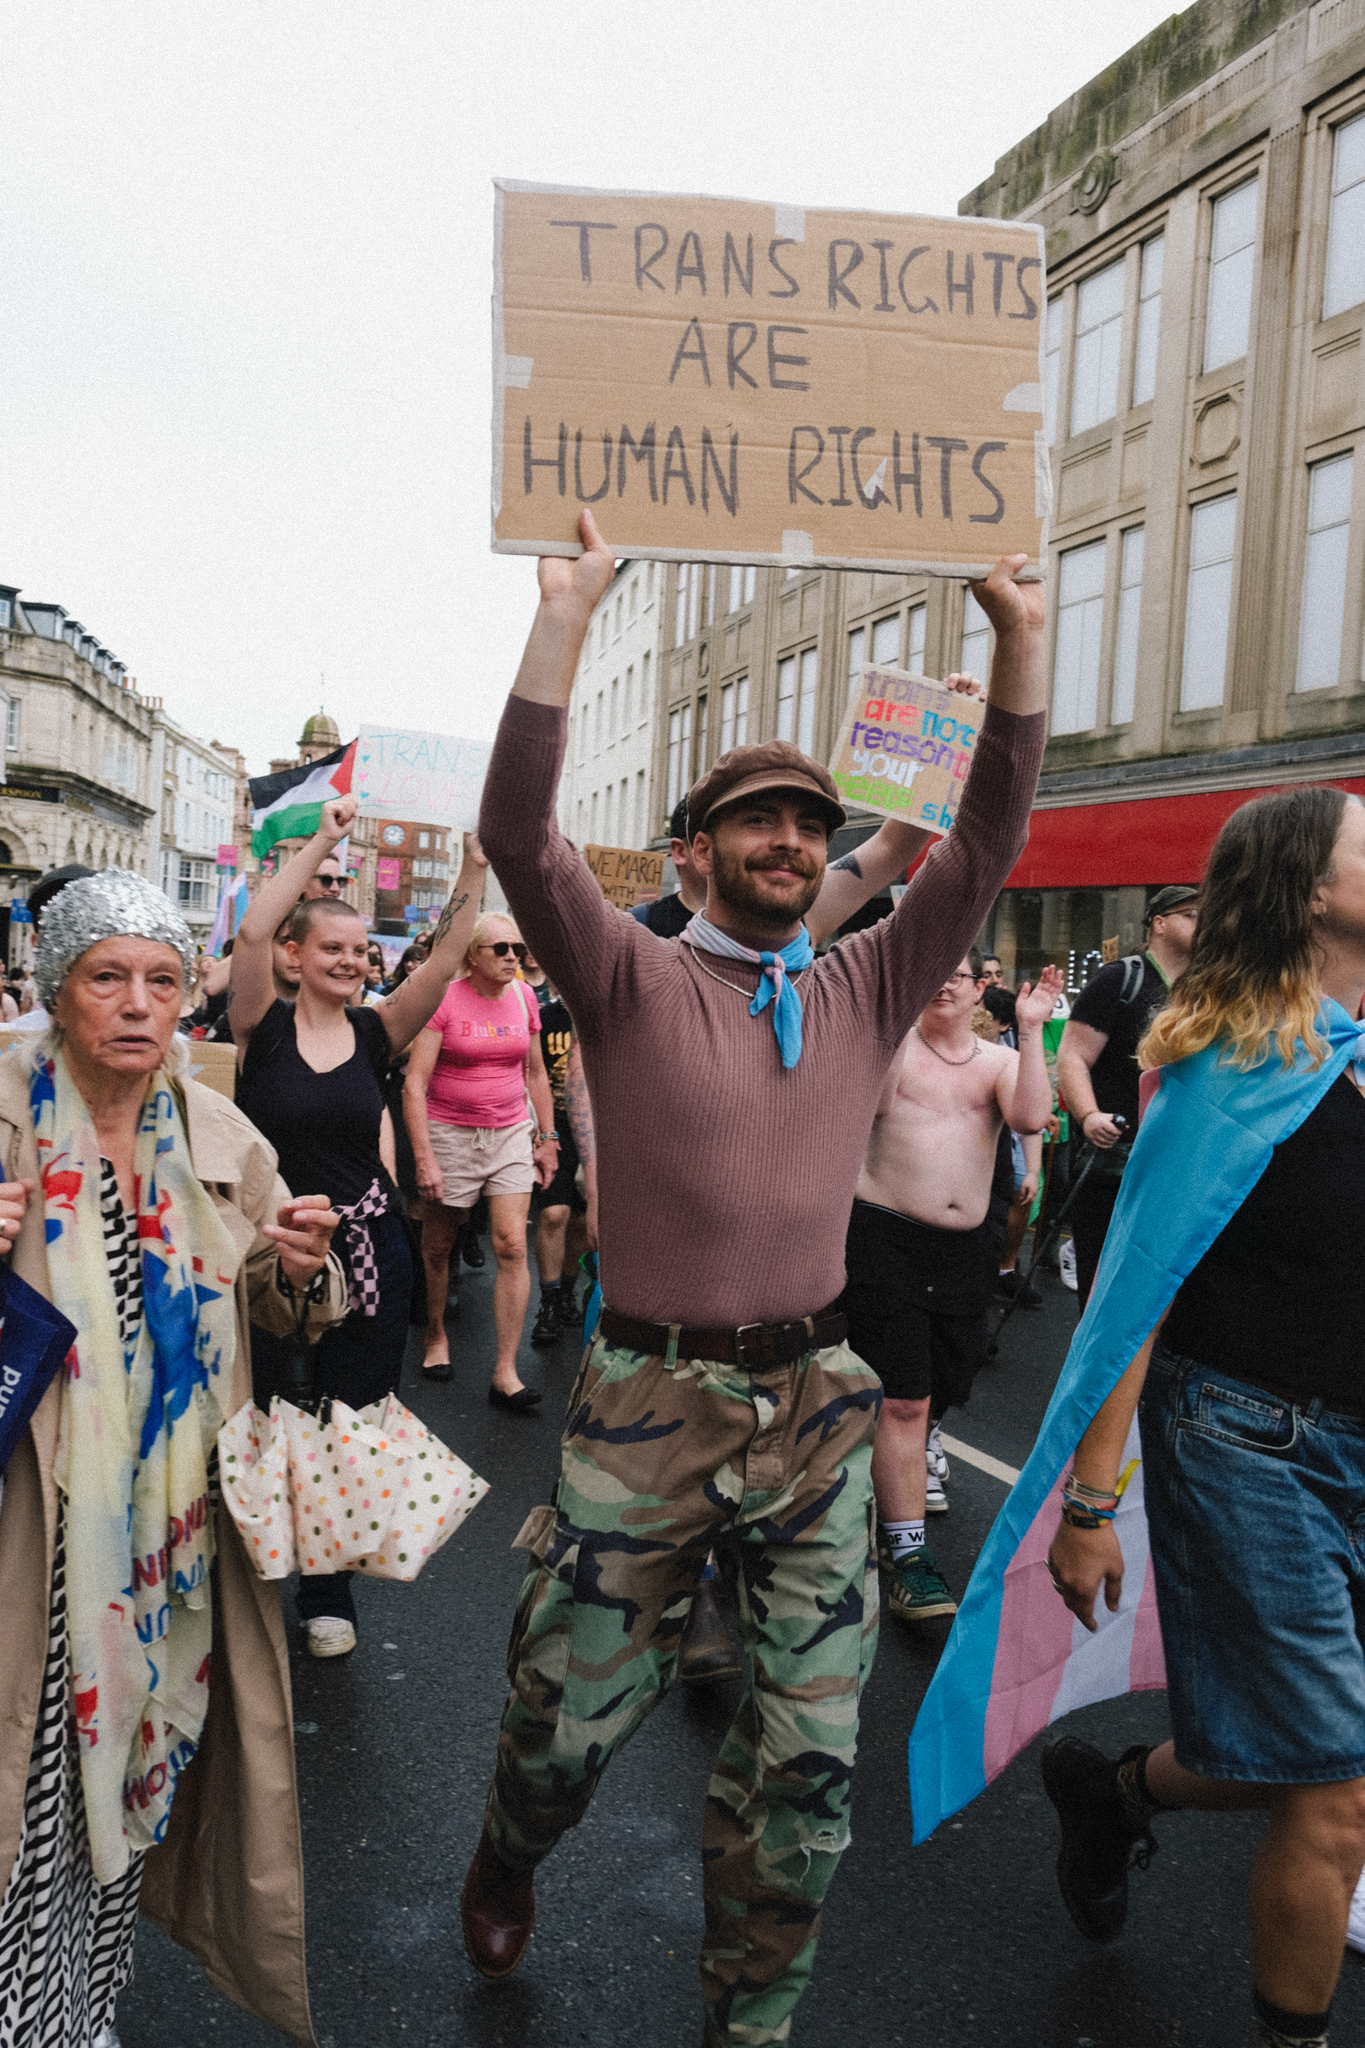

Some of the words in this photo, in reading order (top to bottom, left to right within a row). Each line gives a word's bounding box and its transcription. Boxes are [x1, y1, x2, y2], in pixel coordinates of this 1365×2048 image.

[549, 220, 800, 299] TRANS
[828, 238, 1042, 320] RIGHTS
[668, 316, 811, 391] ARE
[523, 415, 740, 517] HUMAN
[789, 425, 1008, 523] RIGHTS
[864, 670, 953, 711] trans
[850, 721, 955, 770] reason
[864, 699, 919, 726] are
[921, 710, 976, 747] not
[369, 734, 482, 777] TRANS
[849, 750, 924, 788] your
[587, 849, 614, 876] WE
[616, 854, 663, 887] MARCH
[602, 884, 634, 900] WITH
